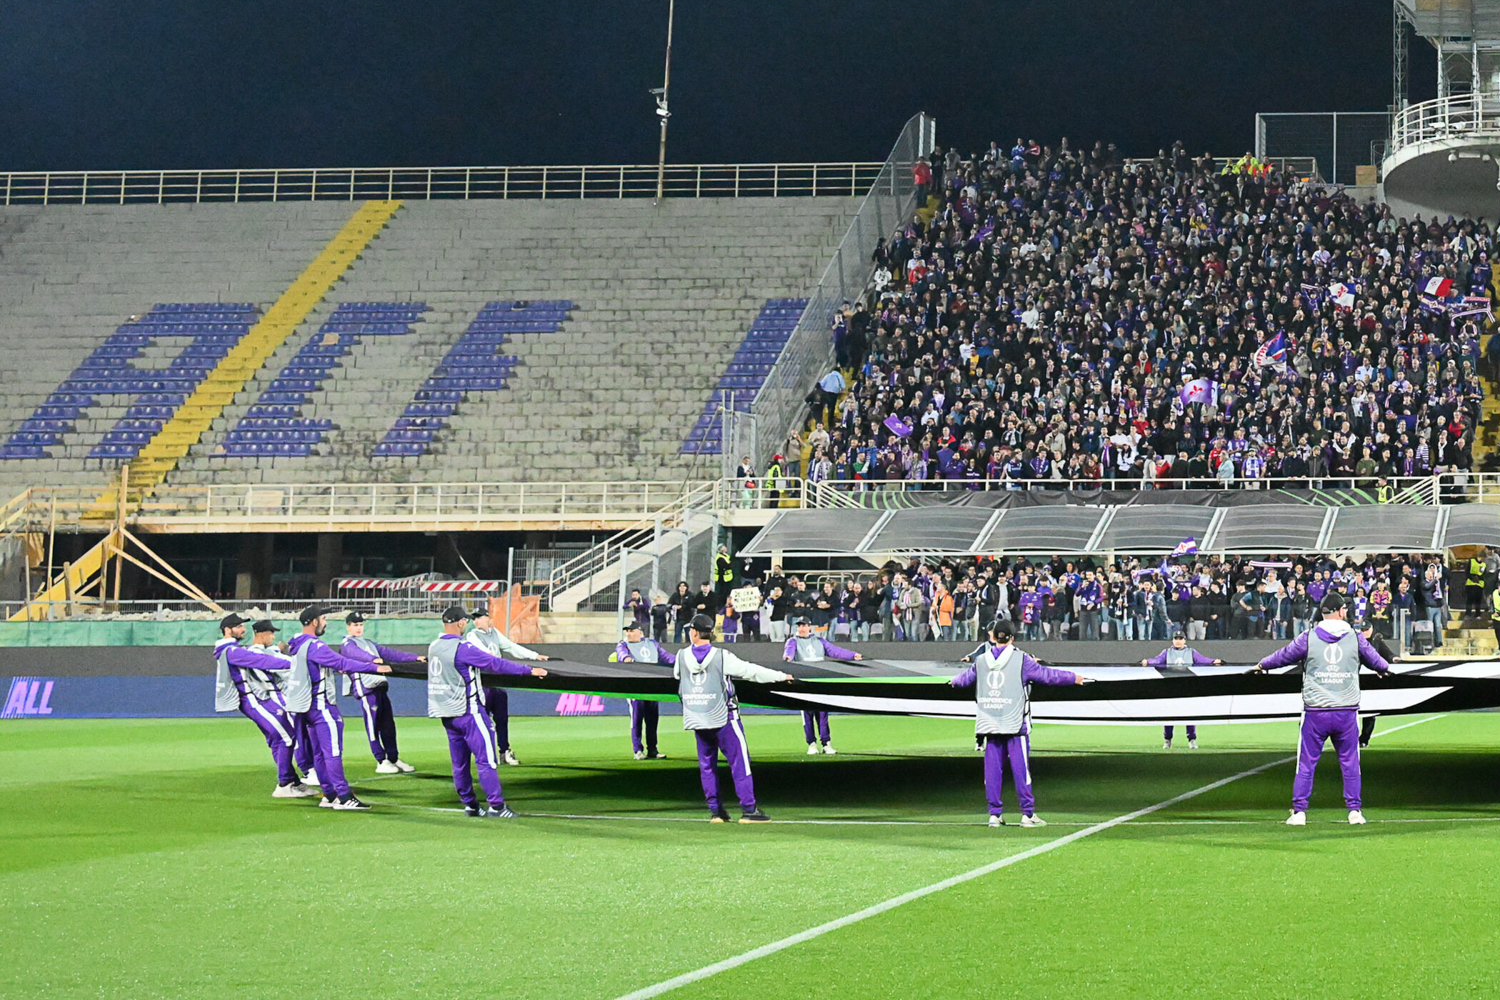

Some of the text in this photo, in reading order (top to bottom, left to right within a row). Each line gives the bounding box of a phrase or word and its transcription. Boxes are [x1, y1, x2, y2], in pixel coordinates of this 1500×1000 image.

[1314, 671, 1351, 679] CONFERENCE
[4, 680, 55, 715] ALL
[555, 692, 605, 712] ALL
